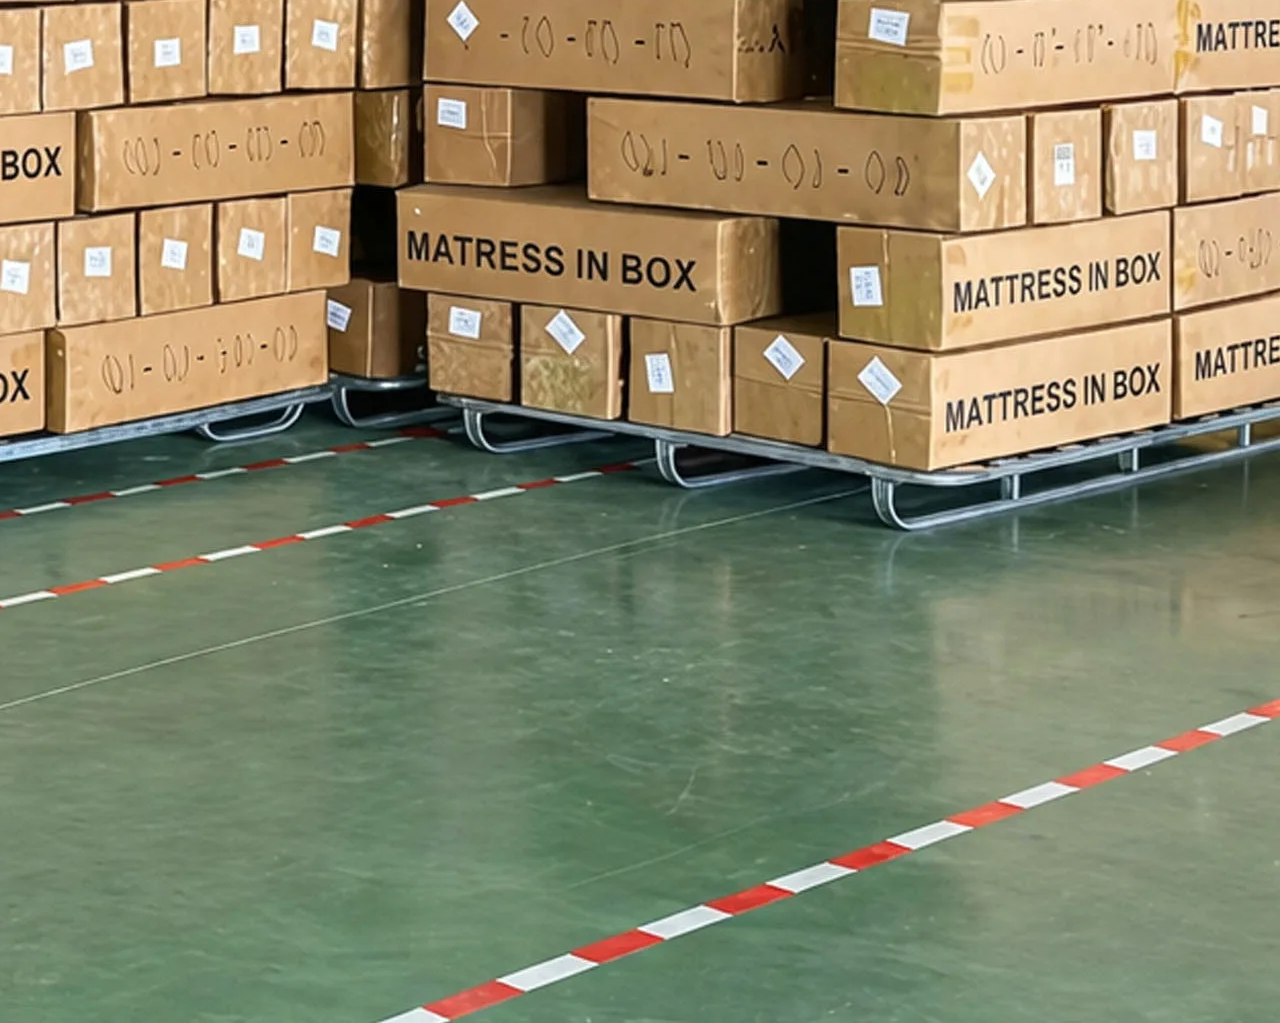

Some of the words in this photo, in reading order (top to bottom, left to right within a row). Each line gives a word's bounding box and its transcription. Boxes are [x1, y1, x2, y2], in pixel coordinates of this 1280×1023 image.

[1, 146, 62, 181] BOX
[407, 230, 565, 277] MATRESS
[577, 248, 609, 282] IN
[621, 253, 697, 292] BOX
[953, 265, 1082, 314] MATTRESS
[1088, 260, 1109, 292] IN
[1115, 251, 1161, 288] BOX
[945, 378, 1077, 434] MATTRESS
[1084, 373, 1106, 406] IN
[1113, 363, 1161, 401] BOX
